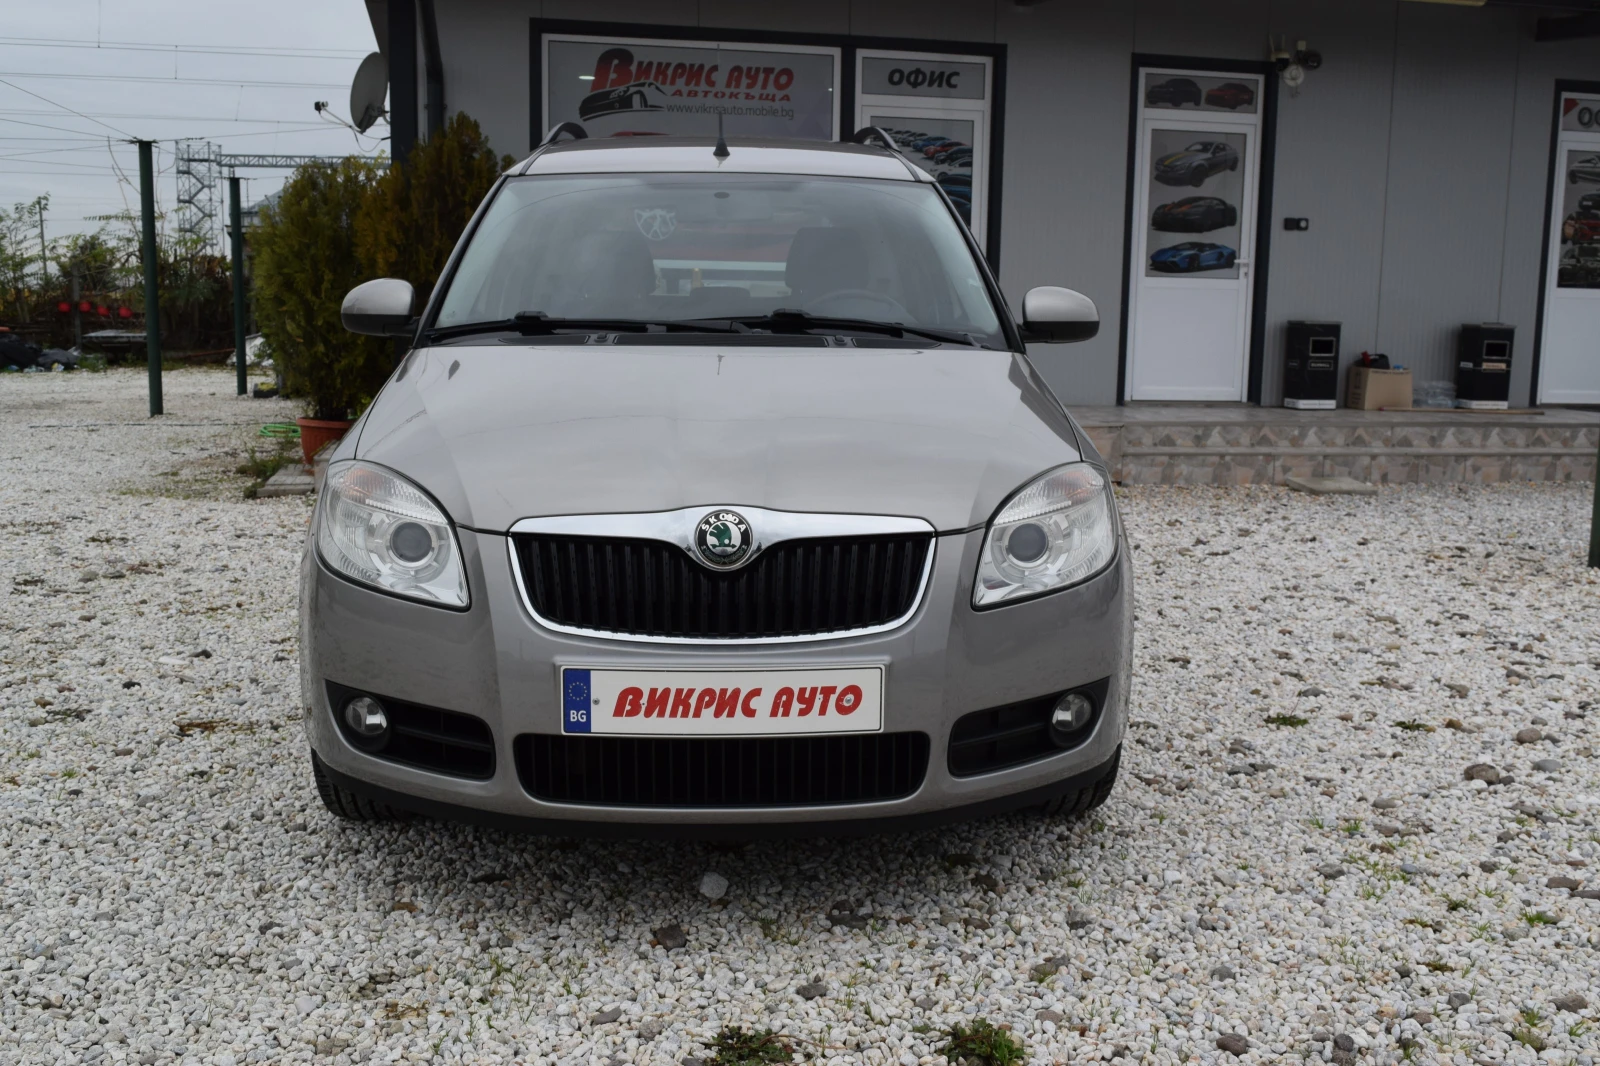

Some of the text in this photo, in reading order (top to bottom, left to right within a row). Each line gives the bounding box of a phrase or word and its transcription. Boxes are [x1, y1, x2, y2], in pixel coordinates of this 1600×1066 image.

[590, 48, 794, 93] ВИКРИС АУТО
[888, 68, 960, 89] ОФИС
[671, 89, 791, 102] АВТОКЪЩА
[666, 103, 794, 120] www.vikrisauto.mobile.bg
[612, 684, 863, 719] ВИКРИС АУТО
[570, 710, 587, 722] BG
